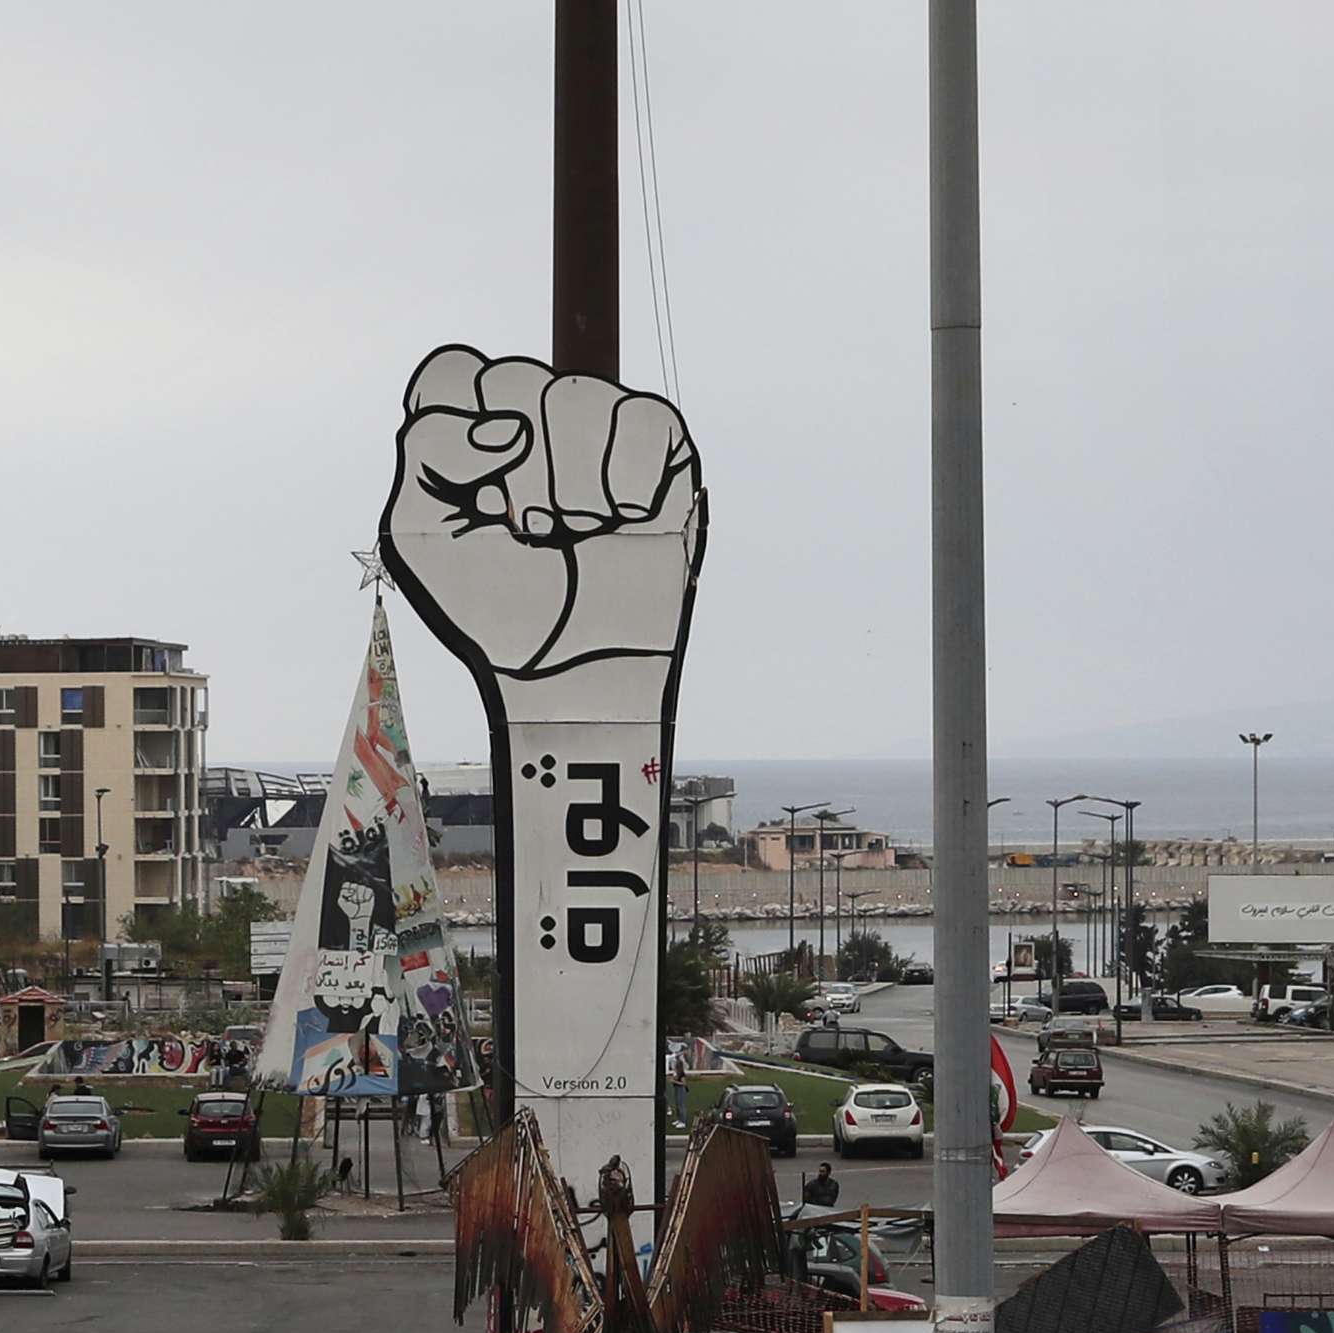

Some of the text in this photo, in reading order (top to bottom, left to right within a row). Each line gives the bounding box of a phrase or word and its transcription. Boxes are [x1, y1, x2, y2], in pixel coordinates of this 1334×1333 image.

[521, 754, 650, 963] ثورة
[542, 1075, 627, 1090] Version 2.0
